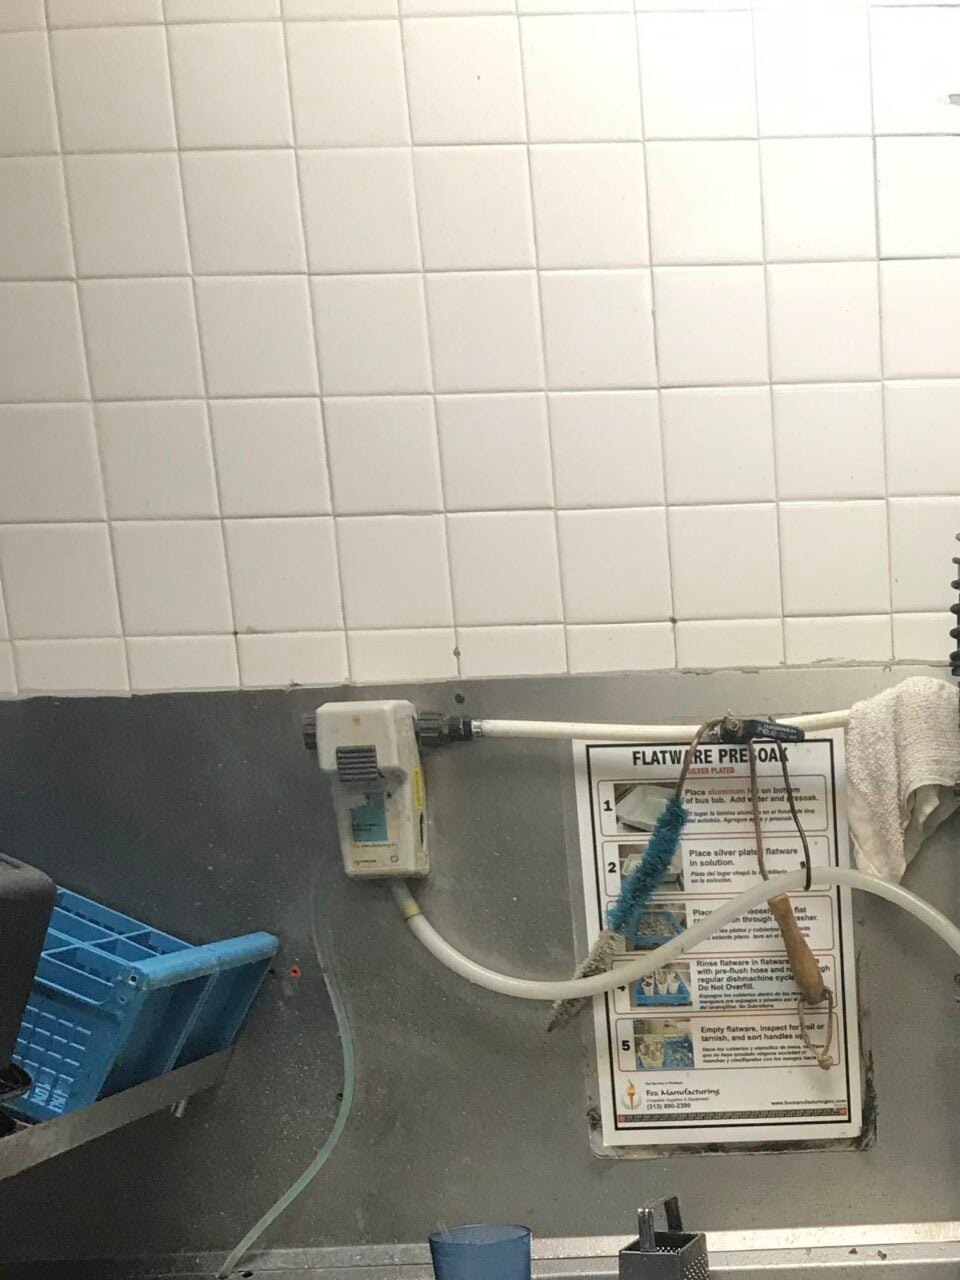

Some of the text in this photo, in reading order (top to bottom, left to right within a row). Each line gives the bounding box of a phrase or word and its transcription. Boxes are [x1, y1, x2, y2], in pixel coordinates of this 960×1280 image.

[632, 747, 789, 766] FLATWRE PREOAK
[711, 766, 735, 775] PLATED
[603, 800, 613, 812] 1
[689, 849, 712, 857] Place
[738, 848, 758, 858] plate
[607, 861, 617, 874] 2
[715, 967, 748, 976] pre-flush
[698, 976, 724, 984] regular
[701, 1026, 724, 1034] Empty
[760, 1024, 787, 1032] inspect
[621, 1040, 631, 1052] 5
[646, 1087, 720, 1097] Fox Manufacturing
